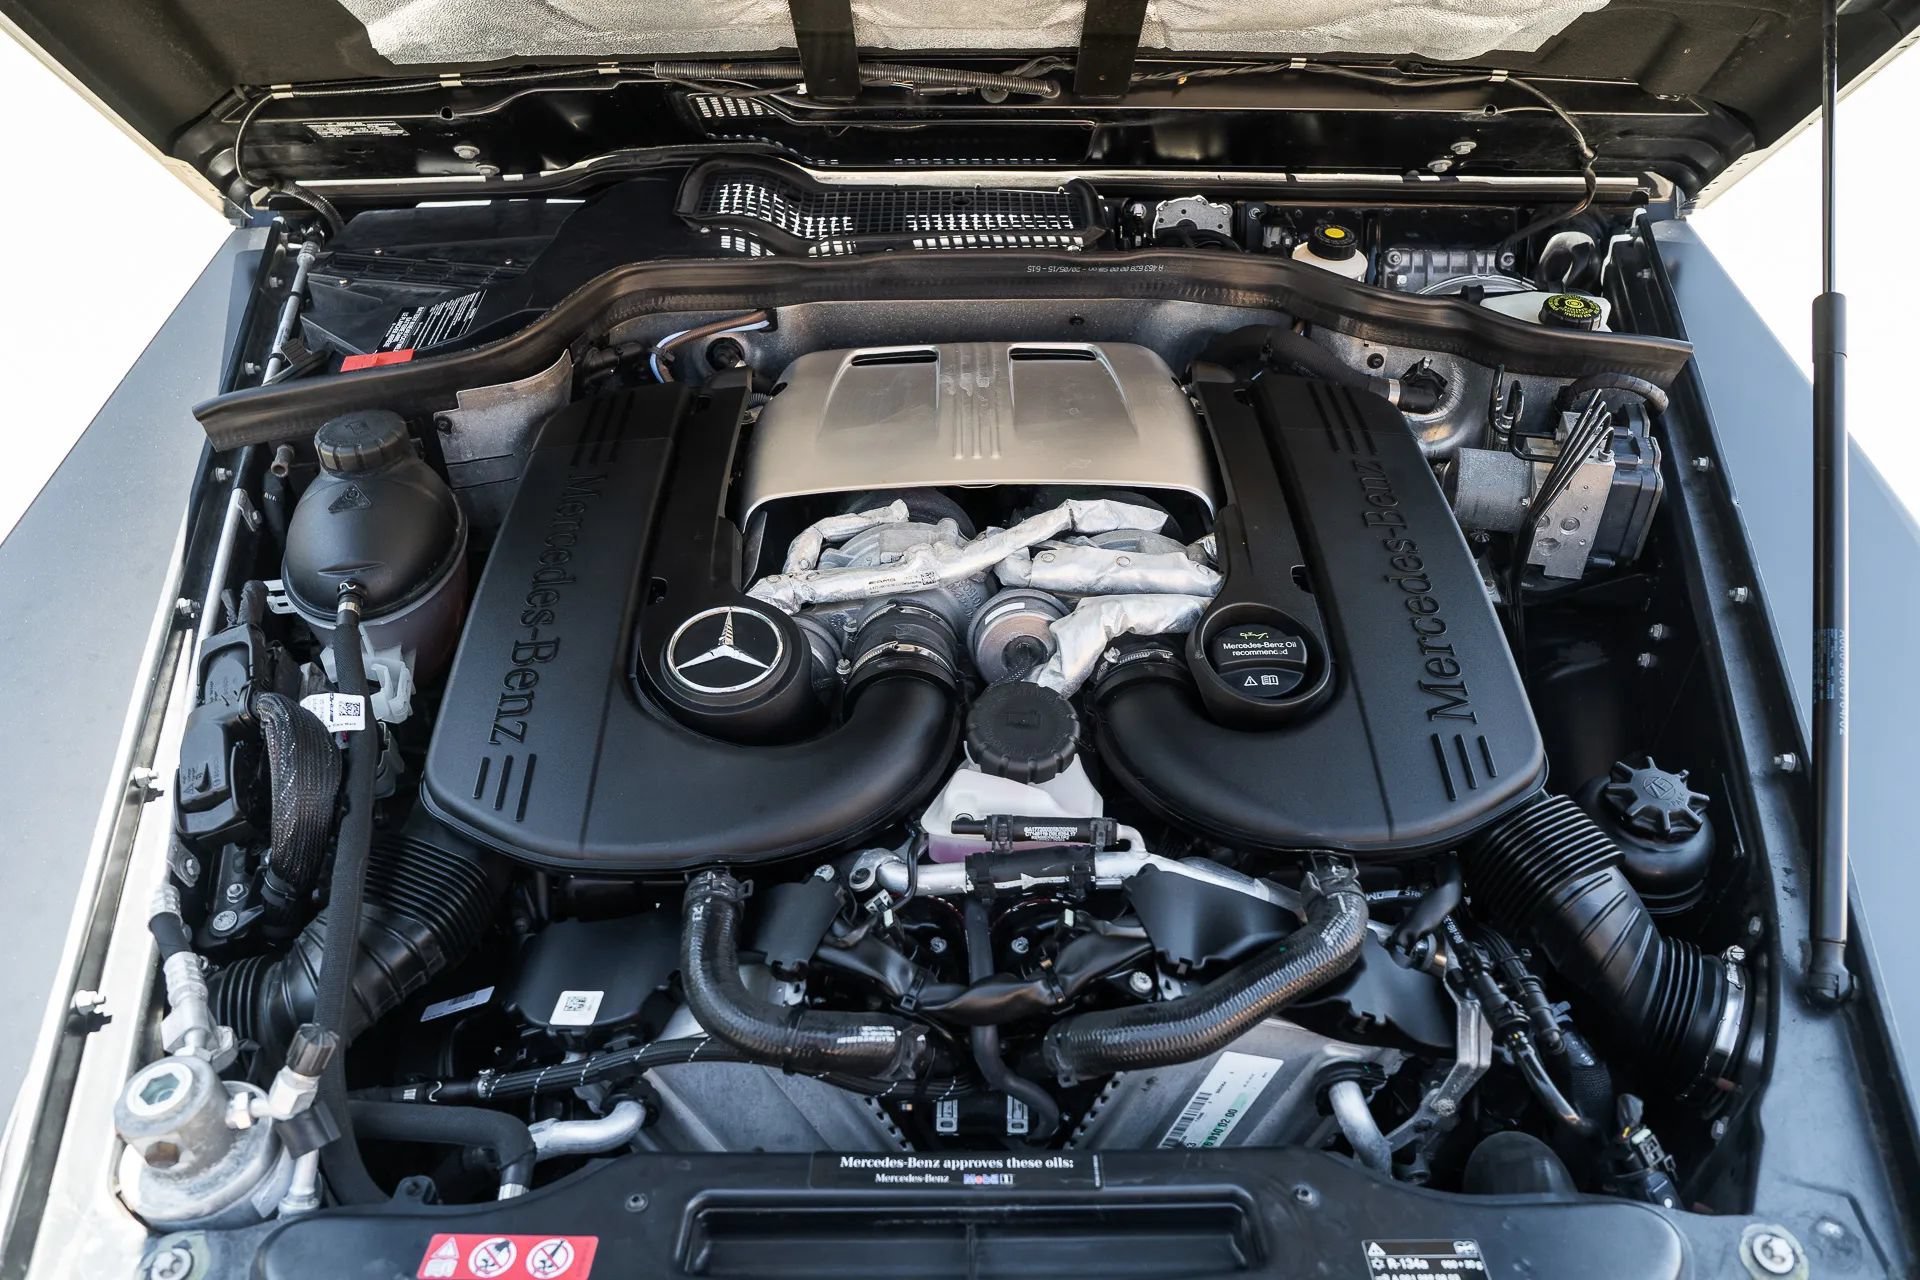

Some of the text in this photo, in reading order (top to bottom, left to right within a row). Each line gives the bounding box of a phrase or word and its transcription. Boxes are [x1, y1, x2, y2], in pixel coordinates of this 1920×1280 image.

[1351, 459, 1478, 725] Mercedes-Benz
[488, 474, 608, 745] Mercedes-Benz
[1223, 641, 1284, 650] Mercedes-Benz
[840, 1156, 1074, 1170] Mercedes-Benz approves these oils:
[874, 1173, 950, 1184] Mercedes-Benz
